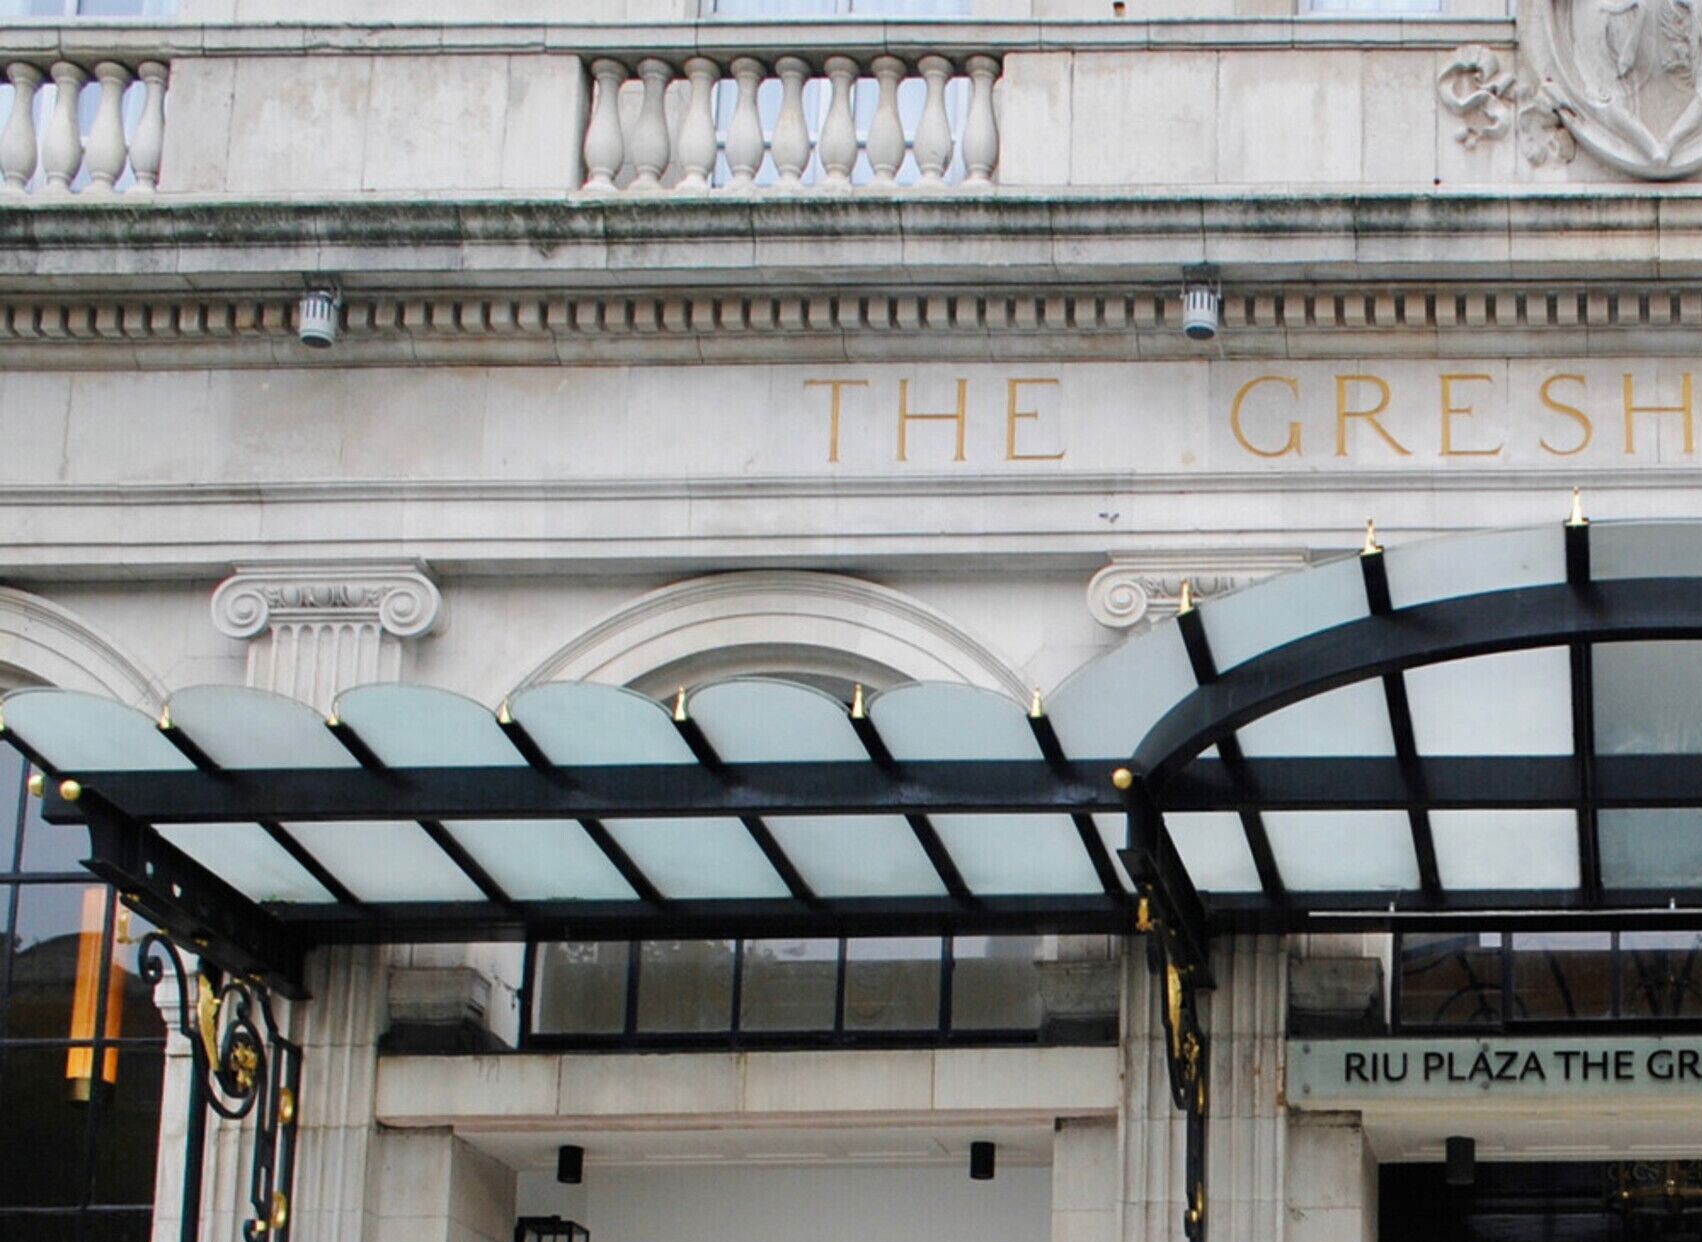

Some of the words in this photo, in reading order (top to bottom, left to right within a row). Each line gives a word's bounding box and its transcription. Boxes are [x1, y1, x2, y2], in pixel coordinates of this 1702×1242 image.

[803, 377, 1067, 463] THE
[1344, 1052, 1407, 1083] RIU
[1423, 1050, 1545, 1081] PLAZA
[1554, 1050, 1634, 1080] THE
